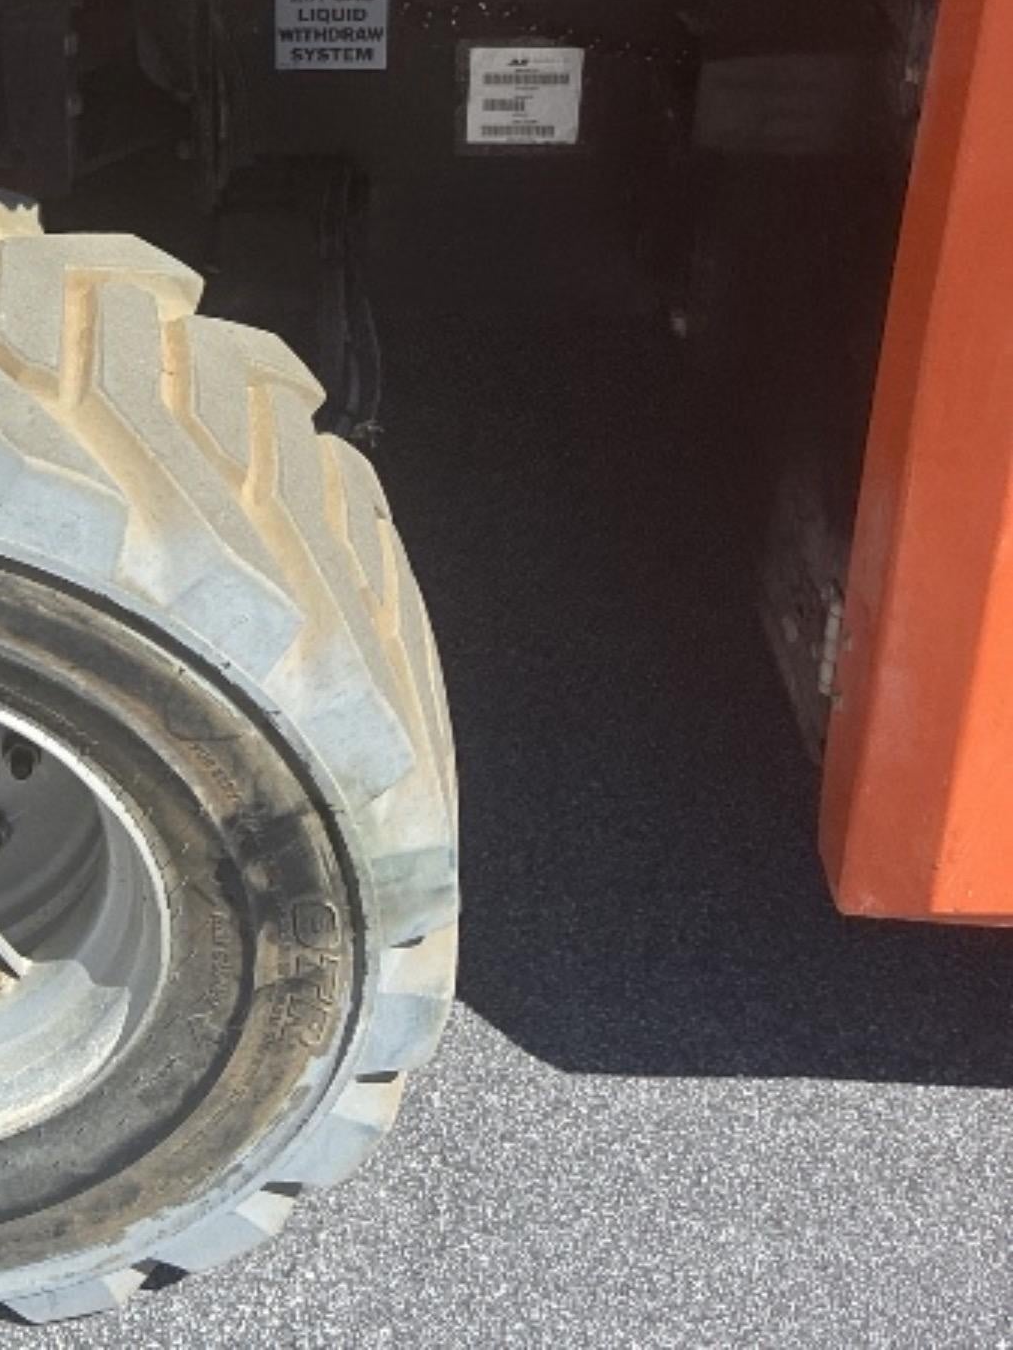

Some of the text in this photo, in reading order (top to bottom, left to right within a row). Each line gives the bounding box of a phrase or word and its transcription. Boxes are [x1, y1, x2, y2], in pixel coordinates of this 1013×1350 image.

[298, 7, 368, 24] LIQUID
[279, 27, 384, 42] WITHDRAW
[291, 47, 374, 62] SYSTEM
